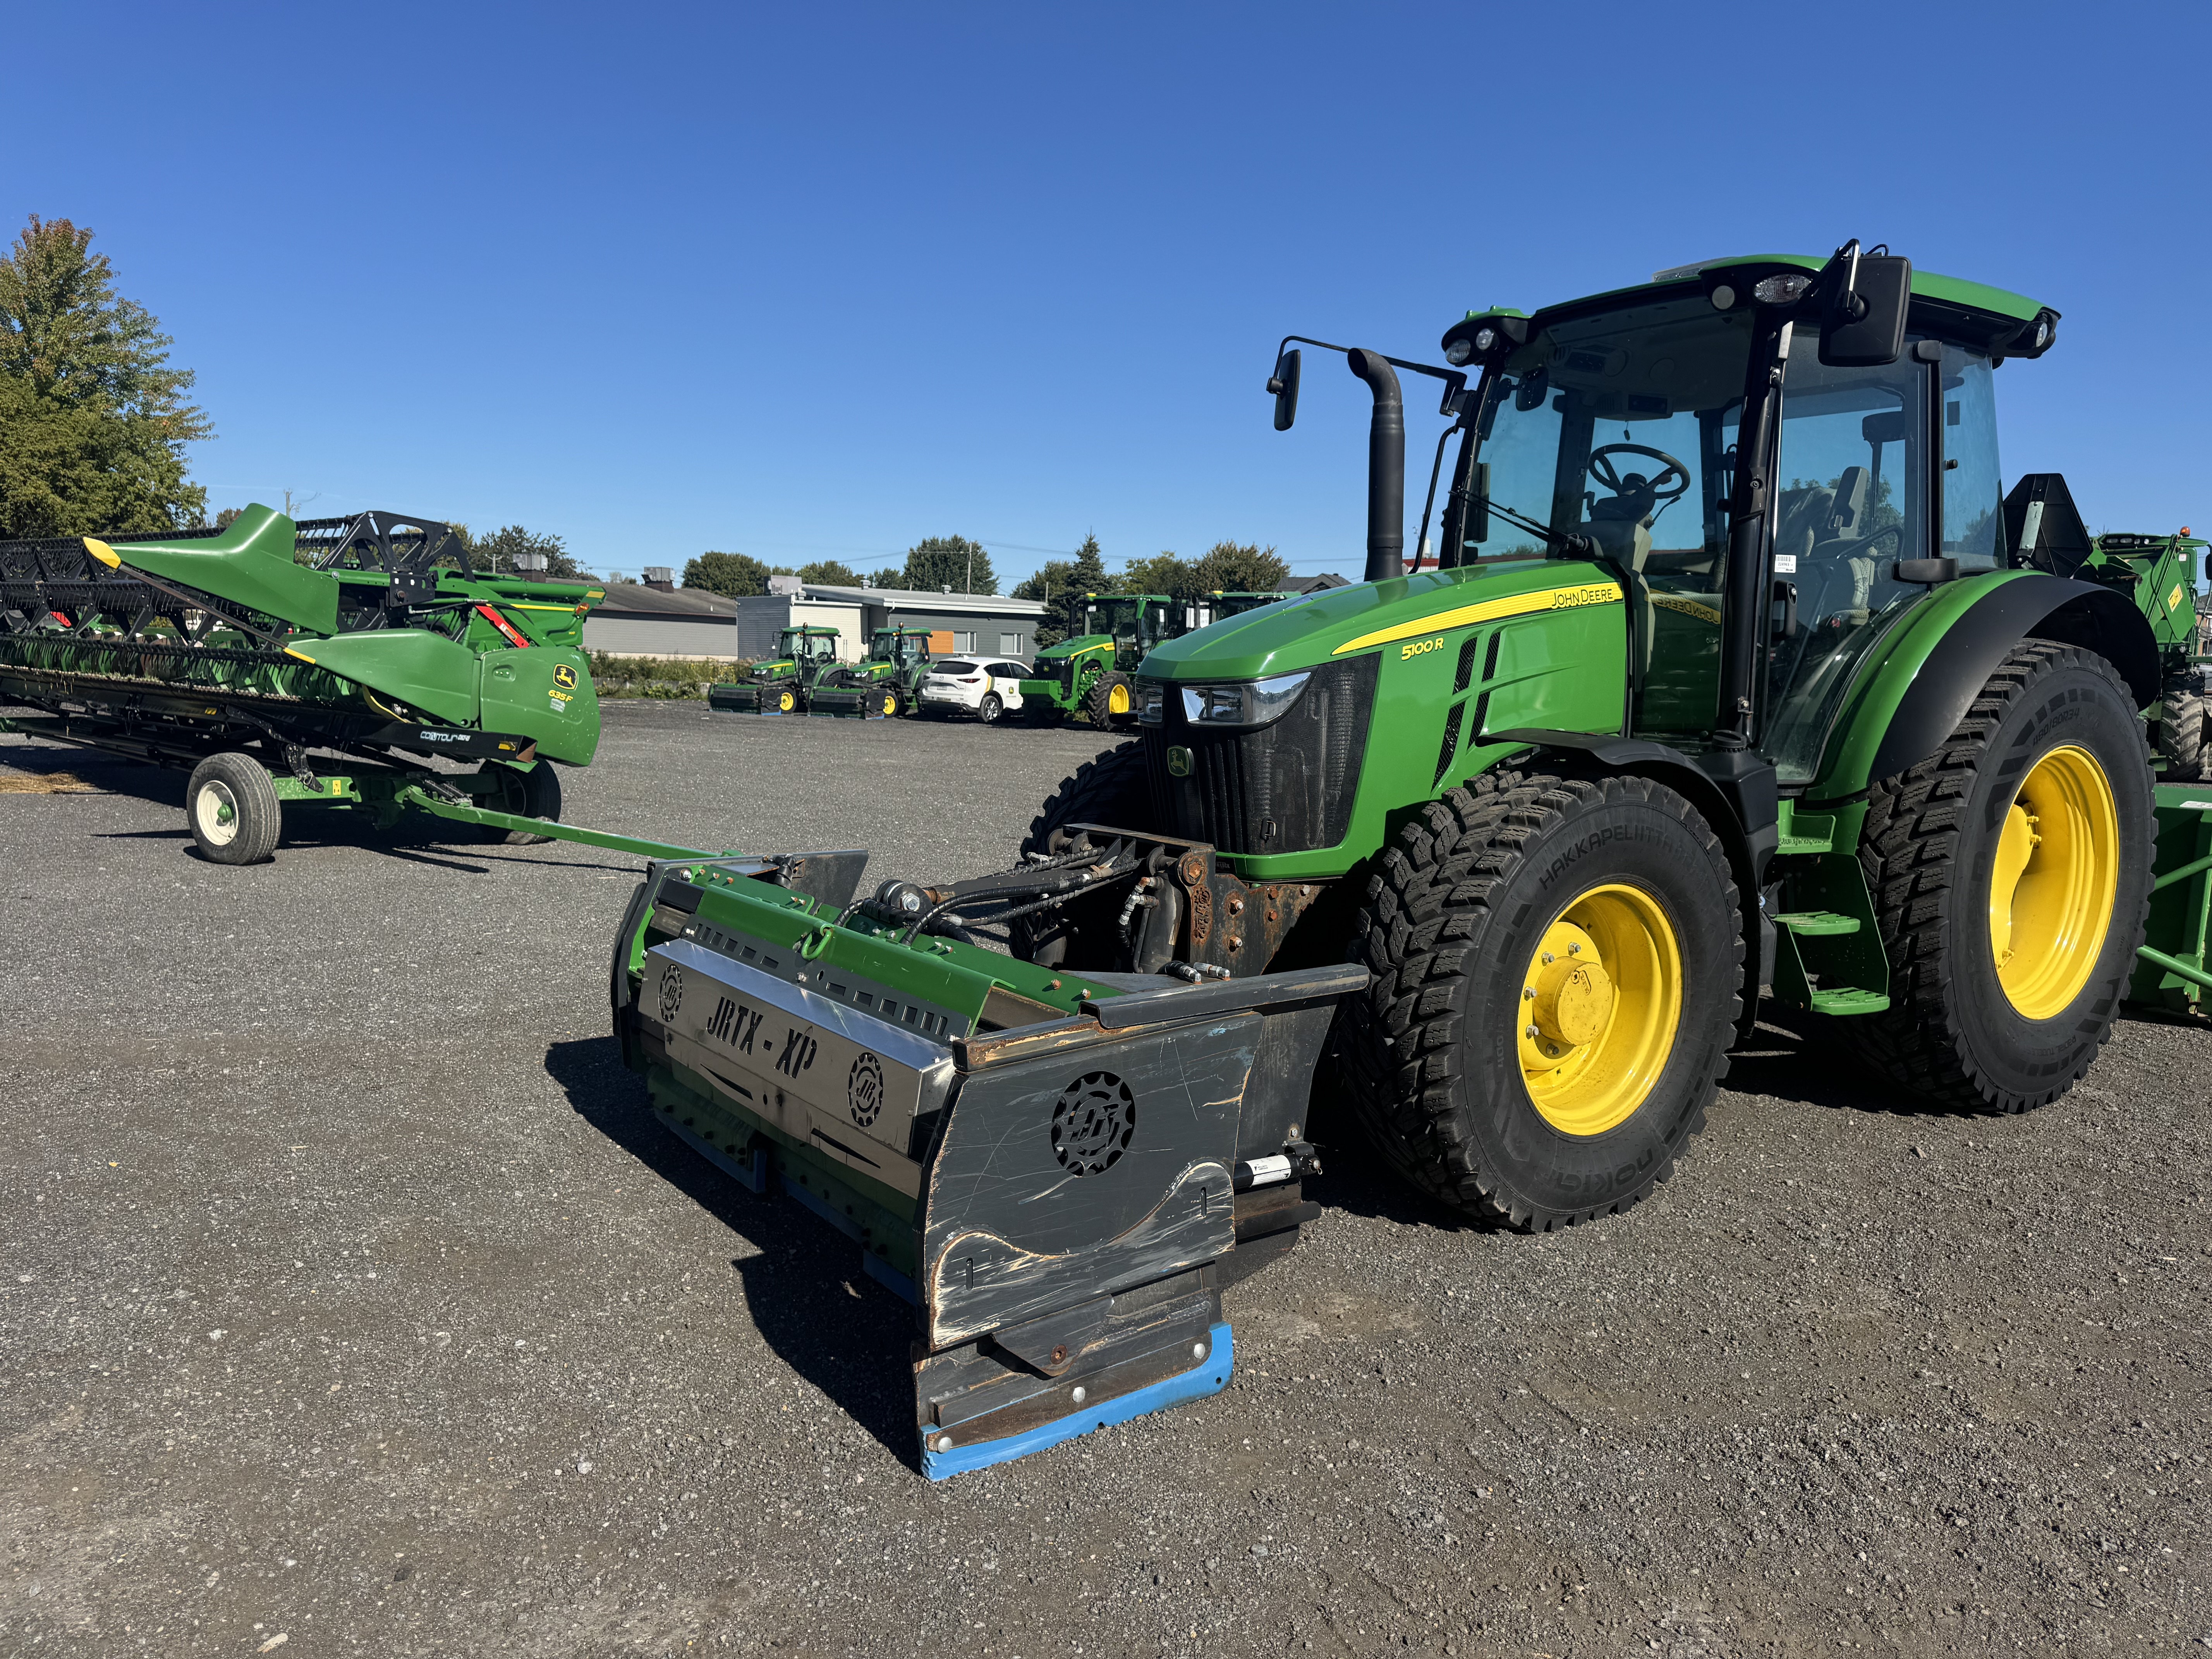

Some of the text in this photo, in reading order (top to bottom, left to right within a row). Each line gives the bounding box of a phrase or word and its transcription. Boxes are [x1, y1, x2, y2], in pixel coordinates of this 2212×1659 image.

[1551, 587, 1614, 609] JOHN DEERE
[1538, 823, 1673, 891] HAKKAPELIITTA
[706, 996, 764, 1056] JRTX
[774, 1027, 818, 1079] XP
[856, 1079, 876, 1102] JR
[1070, 1103, 1120, 1142] JR
